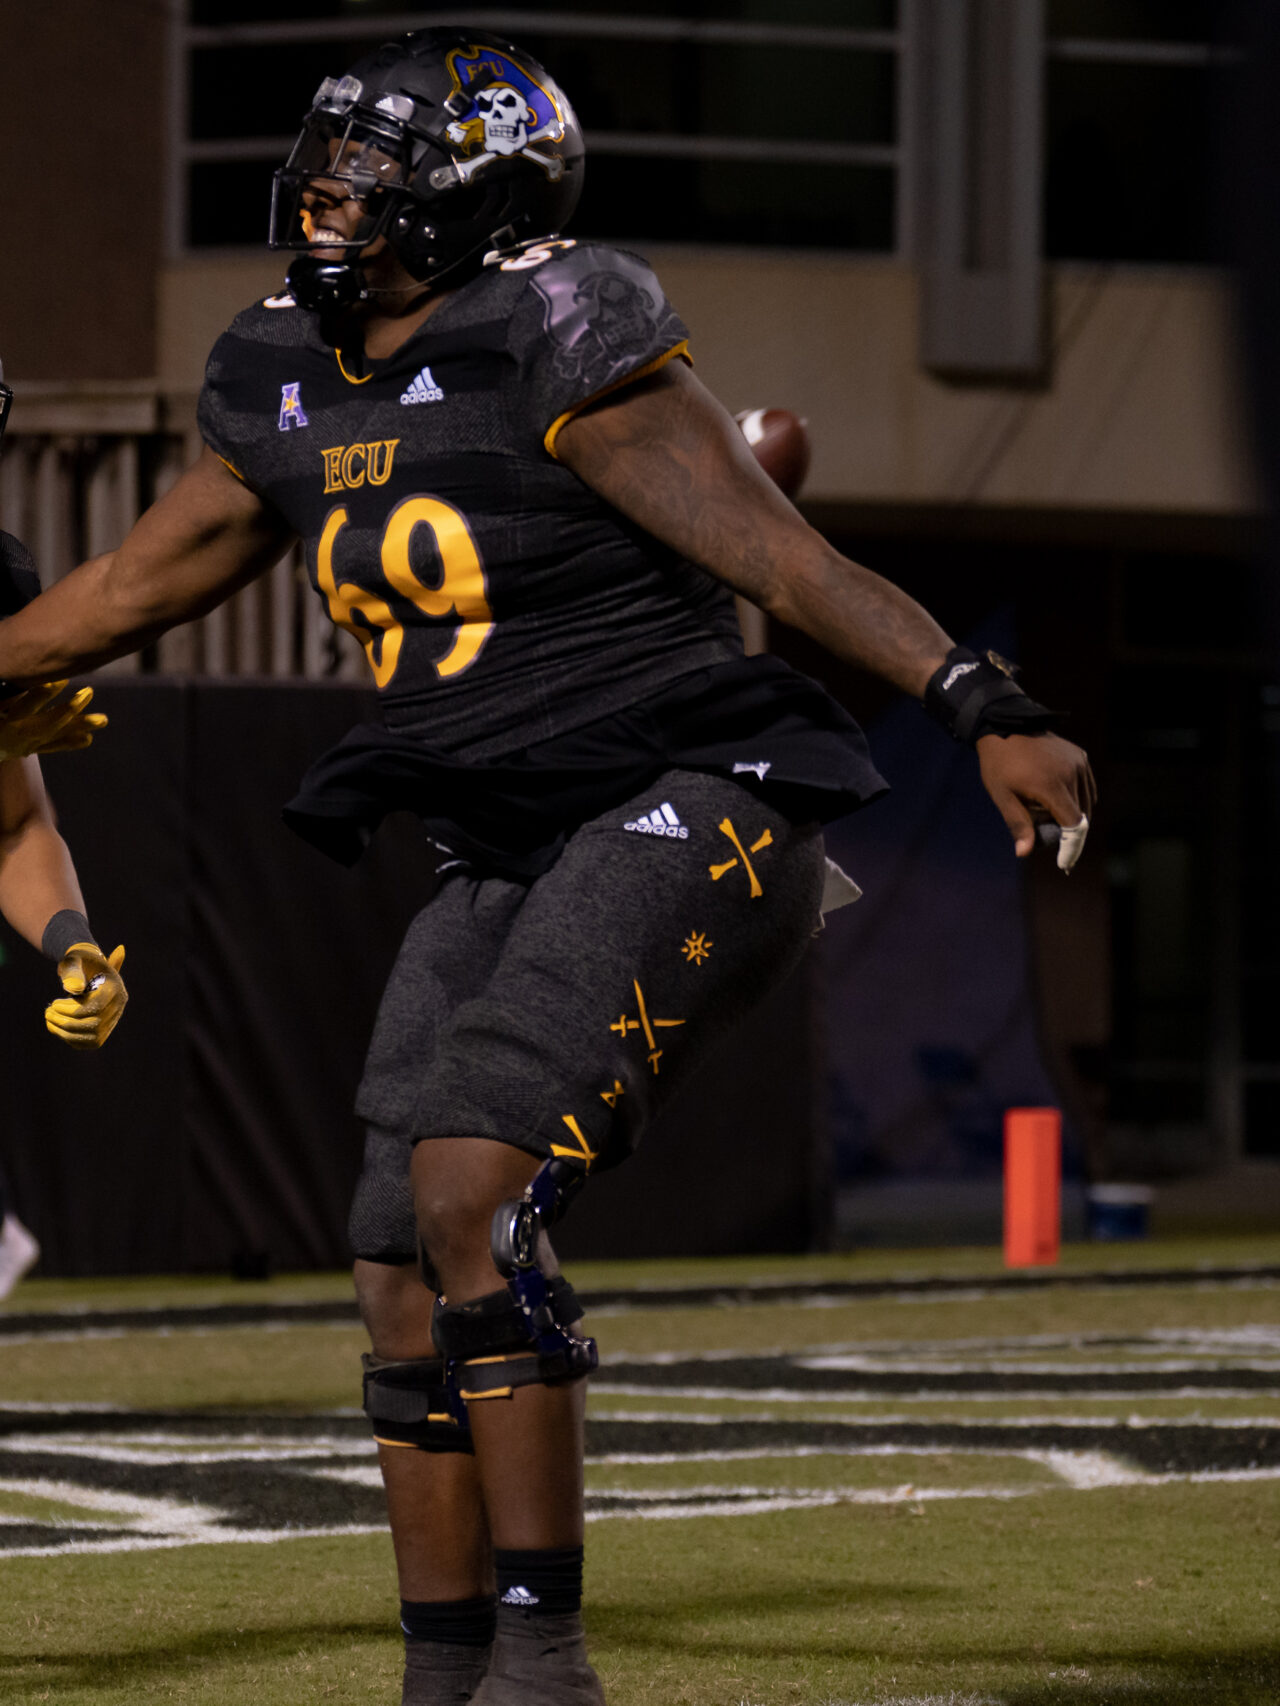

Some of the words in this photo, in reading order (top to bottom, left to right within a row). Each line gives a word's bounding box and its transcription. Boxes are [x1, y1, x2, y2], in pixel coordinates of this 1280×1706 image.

[400, 387, 444, 406] adidas
[321, 438, 400, 495] ECU
[316, 492, 496, 692] 69
[623, 821, 689, 840] adidas
